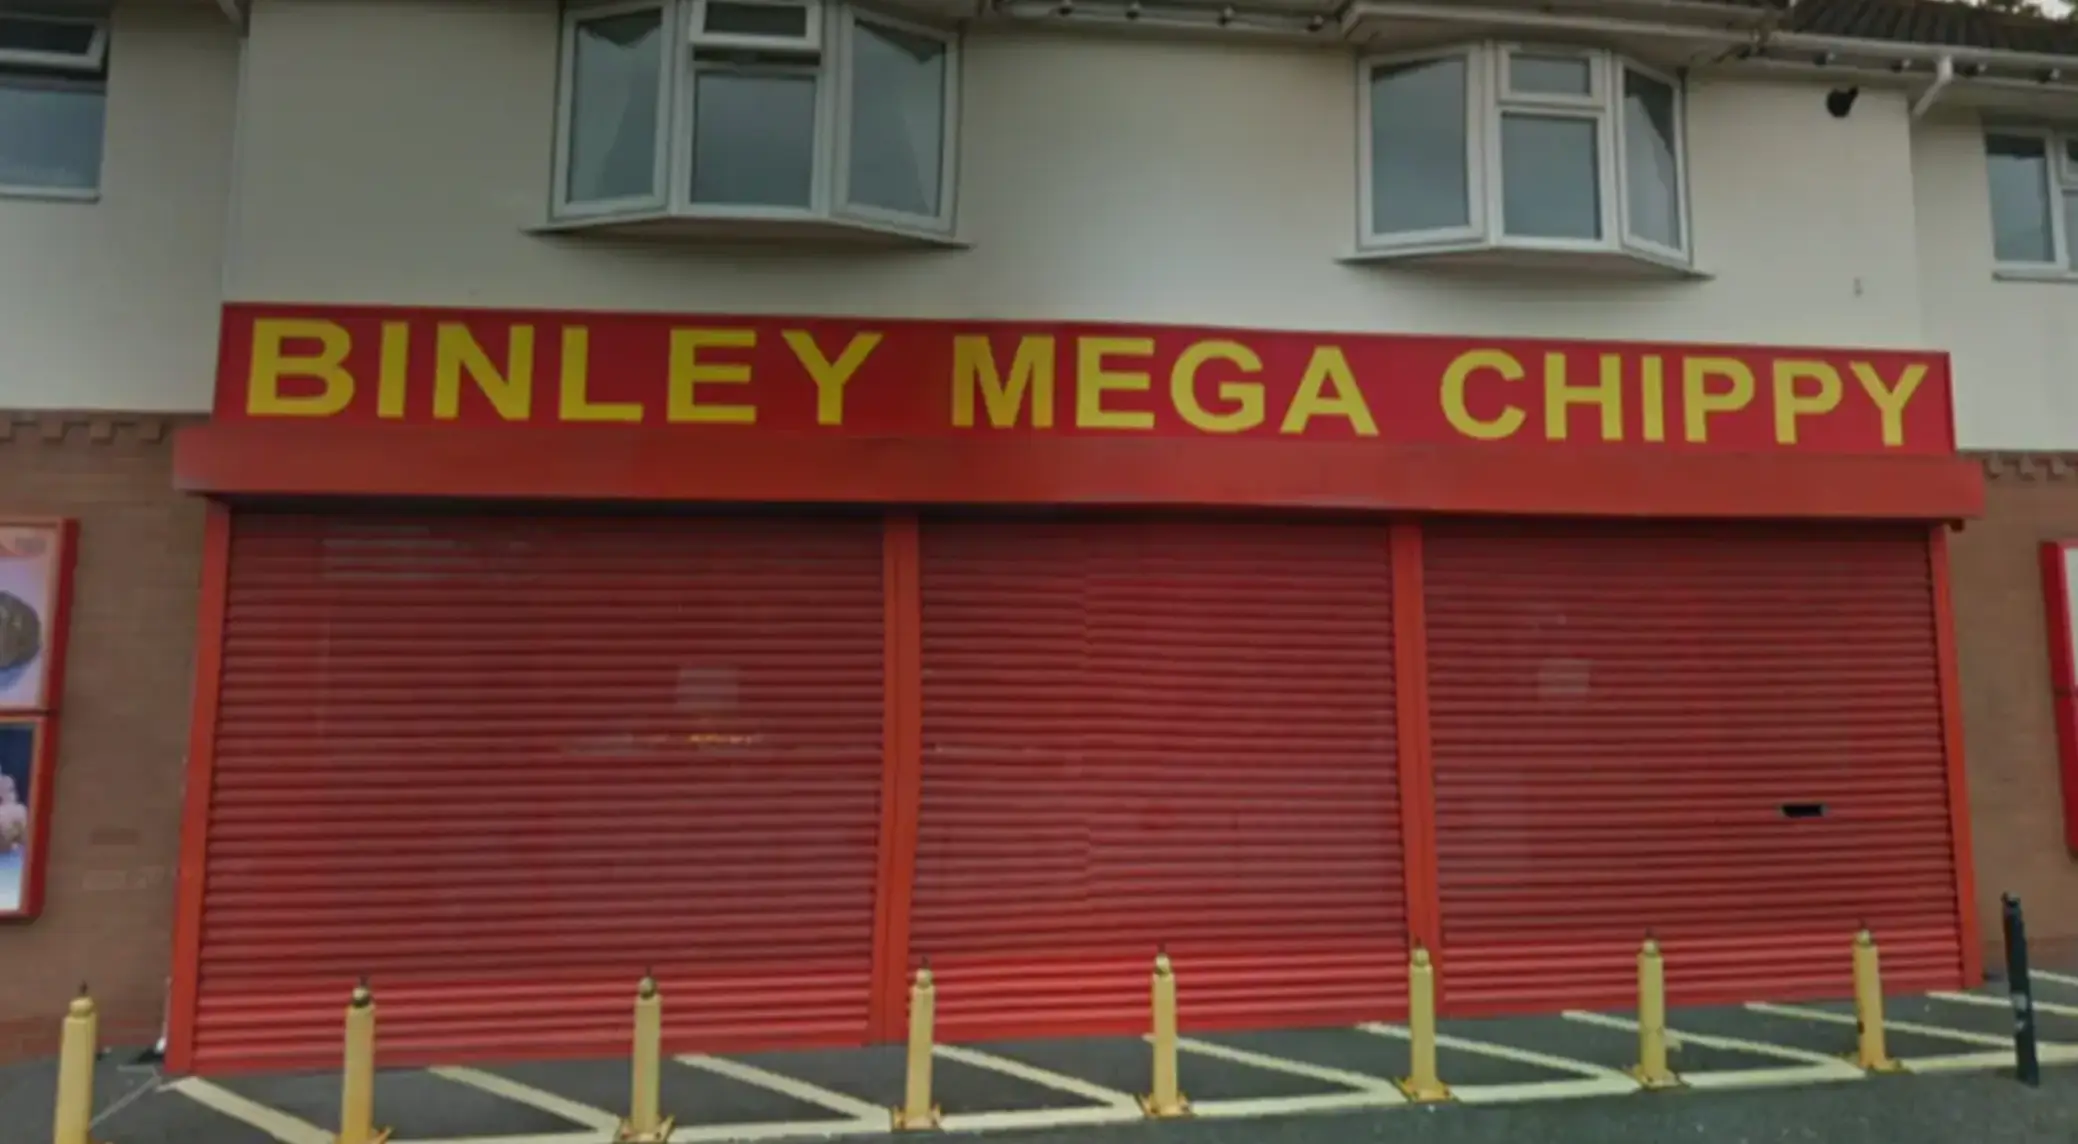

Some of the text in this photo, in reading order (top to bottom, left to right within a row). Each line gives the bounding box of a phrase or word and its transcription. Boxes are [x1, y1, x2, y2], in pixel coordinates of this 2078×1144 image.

[246, 317, 1927, 447] BINLEY MEGA CHIPPY
